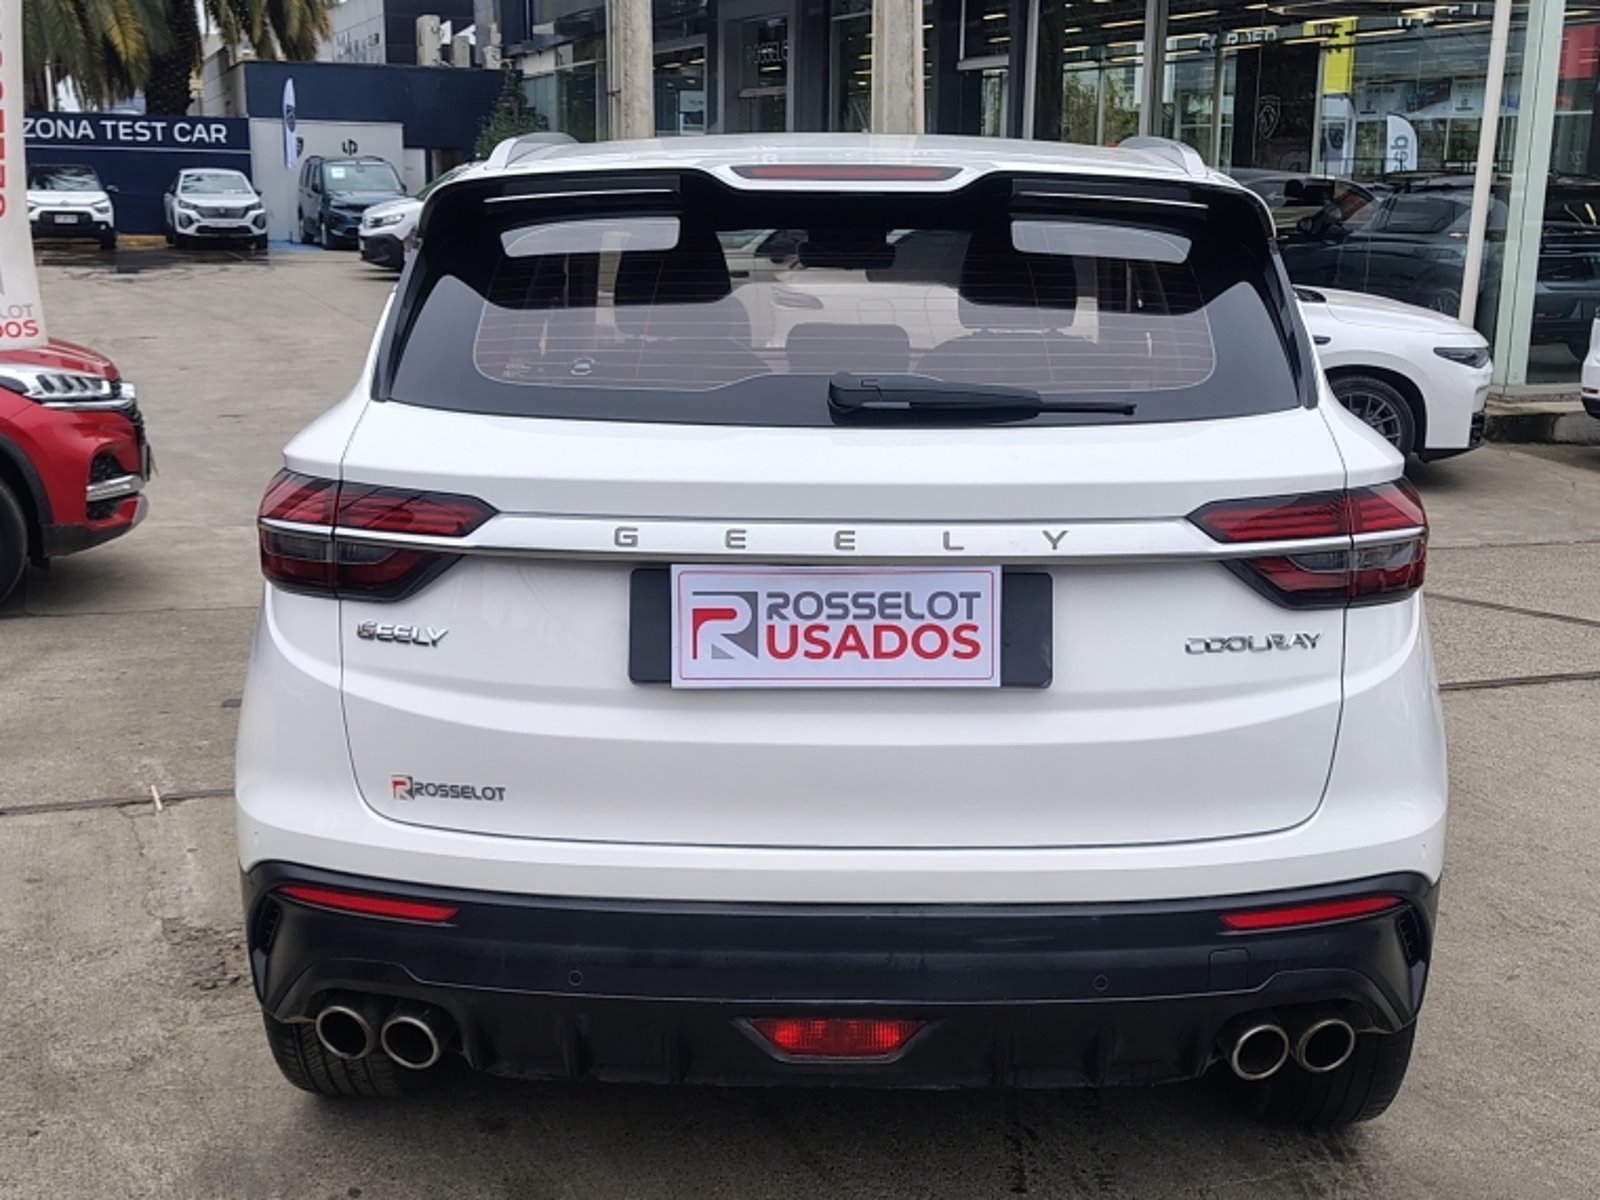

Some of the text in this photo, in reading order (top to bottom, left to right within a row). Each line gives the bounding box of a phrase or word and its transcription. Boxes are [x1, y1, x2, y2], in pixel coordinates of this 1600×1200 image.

[22, 118, 227, 143] ZONA TEST CAR
[0, 319, 39, 338] OS
[614, 527, 1068, 551] GEELY
[766, 591, 981, 620] ROSSELOT
[357, 620, 449, 647] GEELY
[766, 624, 981, 660] USADOS
[1184, 632, 1321, 655] COOLRAY
[414, 782, 506, 801] ROSSELOT
